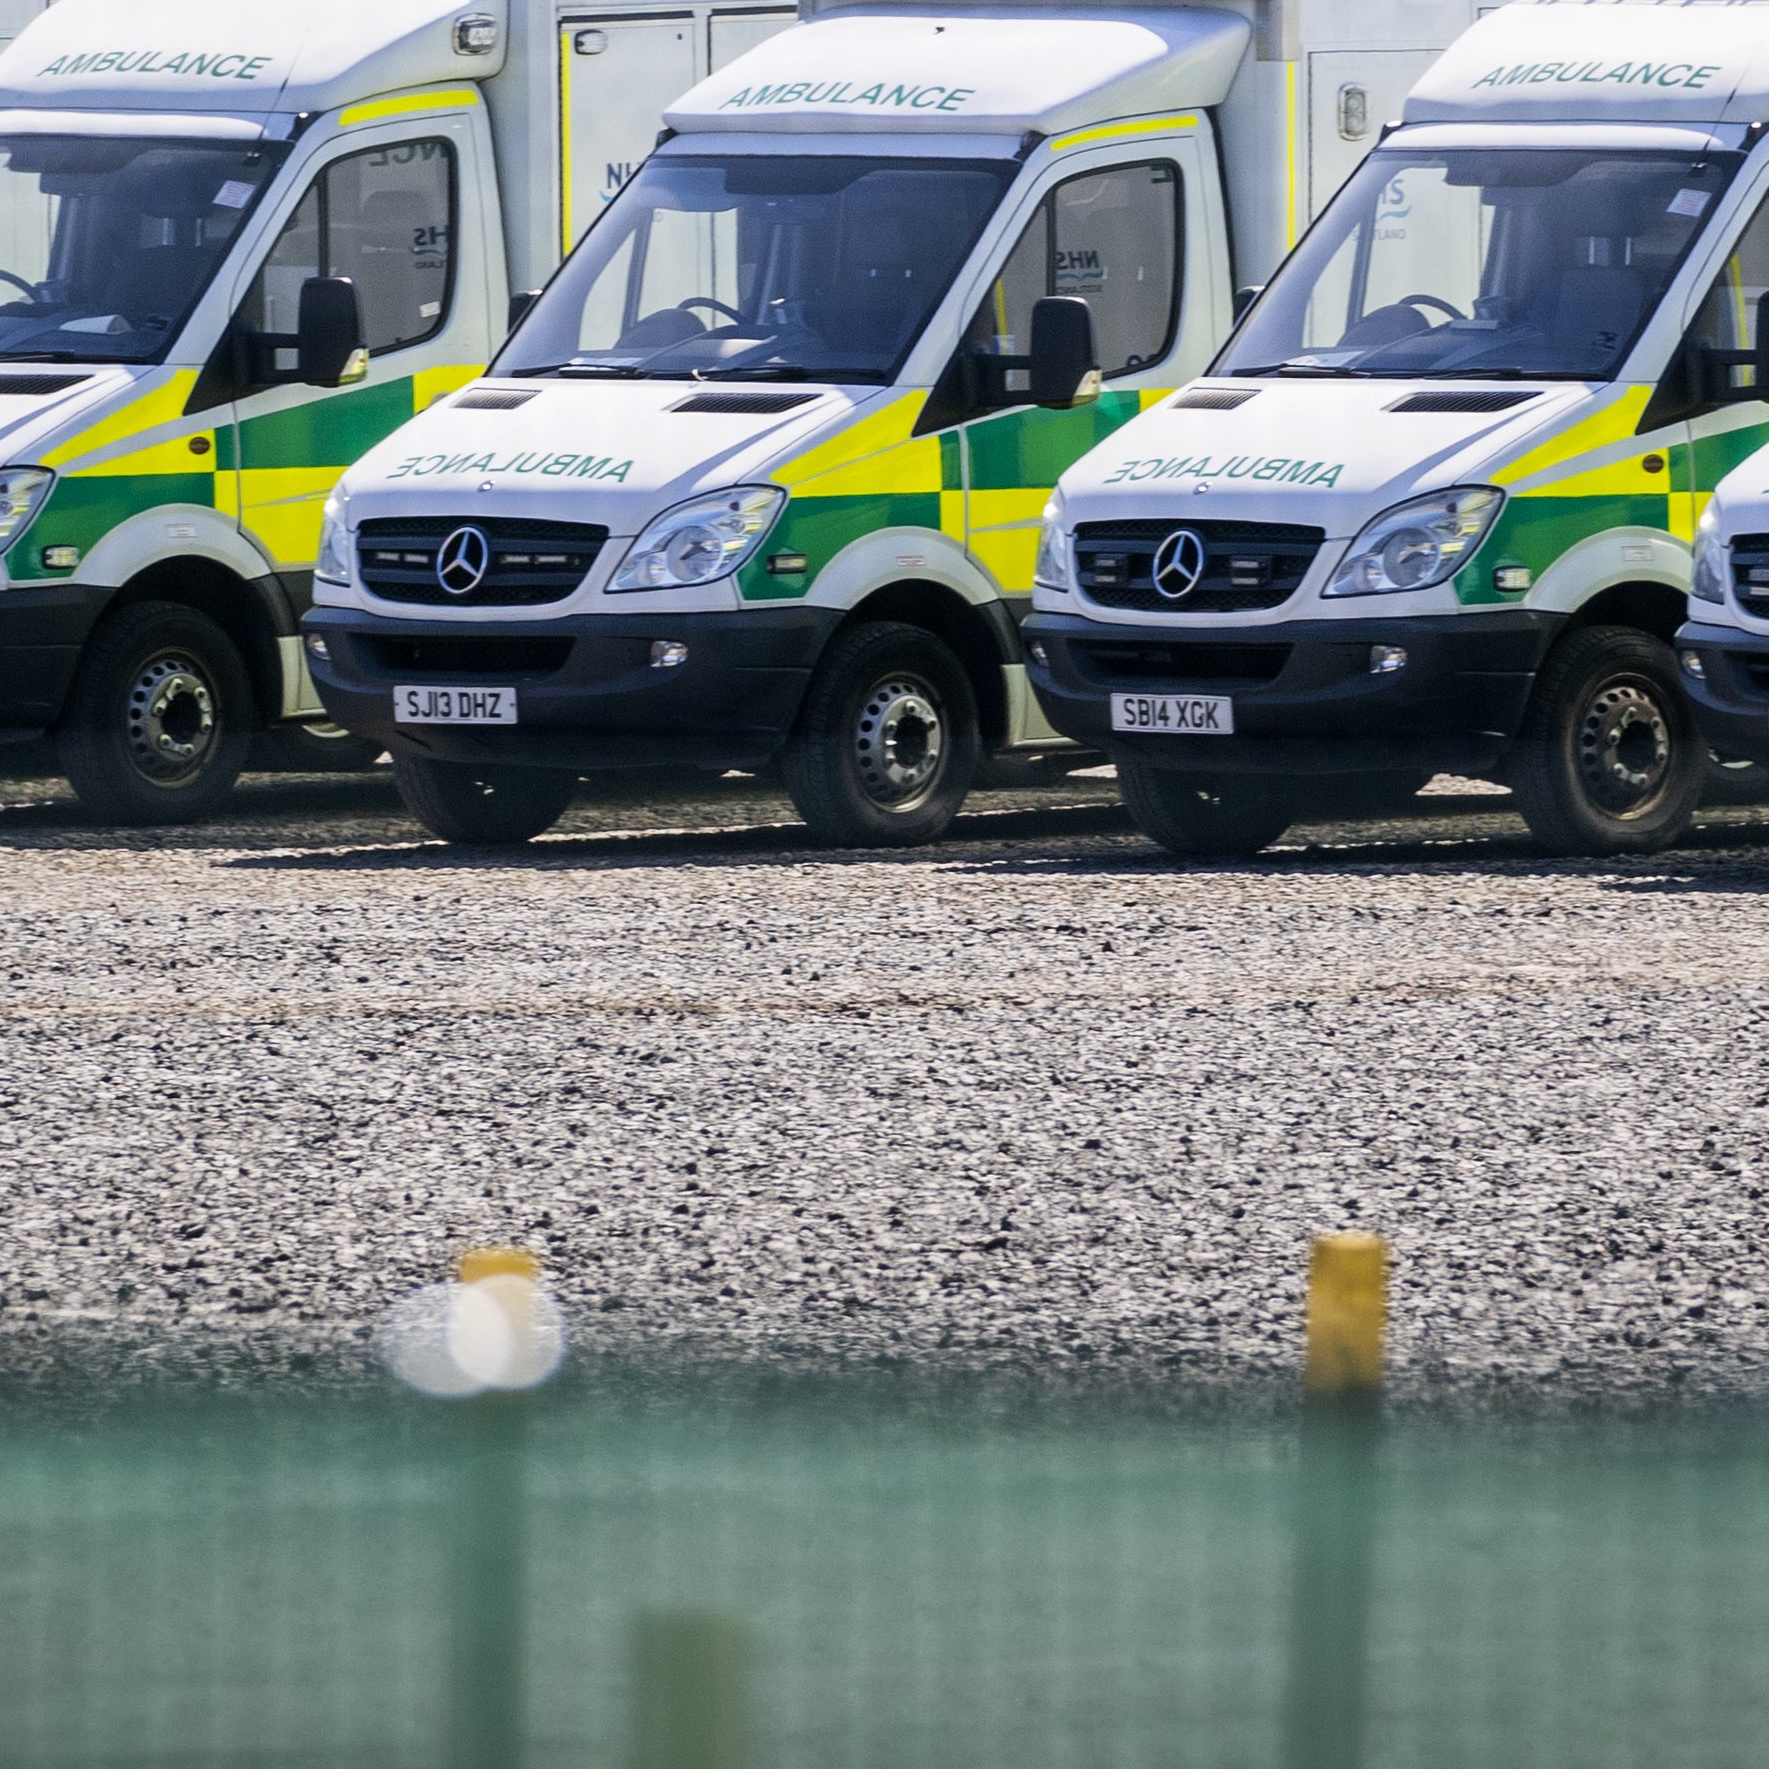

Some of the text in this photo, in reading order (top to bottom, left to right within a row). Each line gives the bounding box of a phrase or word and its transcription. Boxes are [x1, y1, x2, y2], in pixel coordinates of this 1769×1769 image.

[36, 51, 273, 80] AMBULANCE
[1470, 62, 1722, 89] AMBULANCE
[718, 82, 976, 111] AMBULANCE
[407, 691, 502, 719] SJ13 DHZ
[1124, 698, 1220, 729] SB14 XGK
